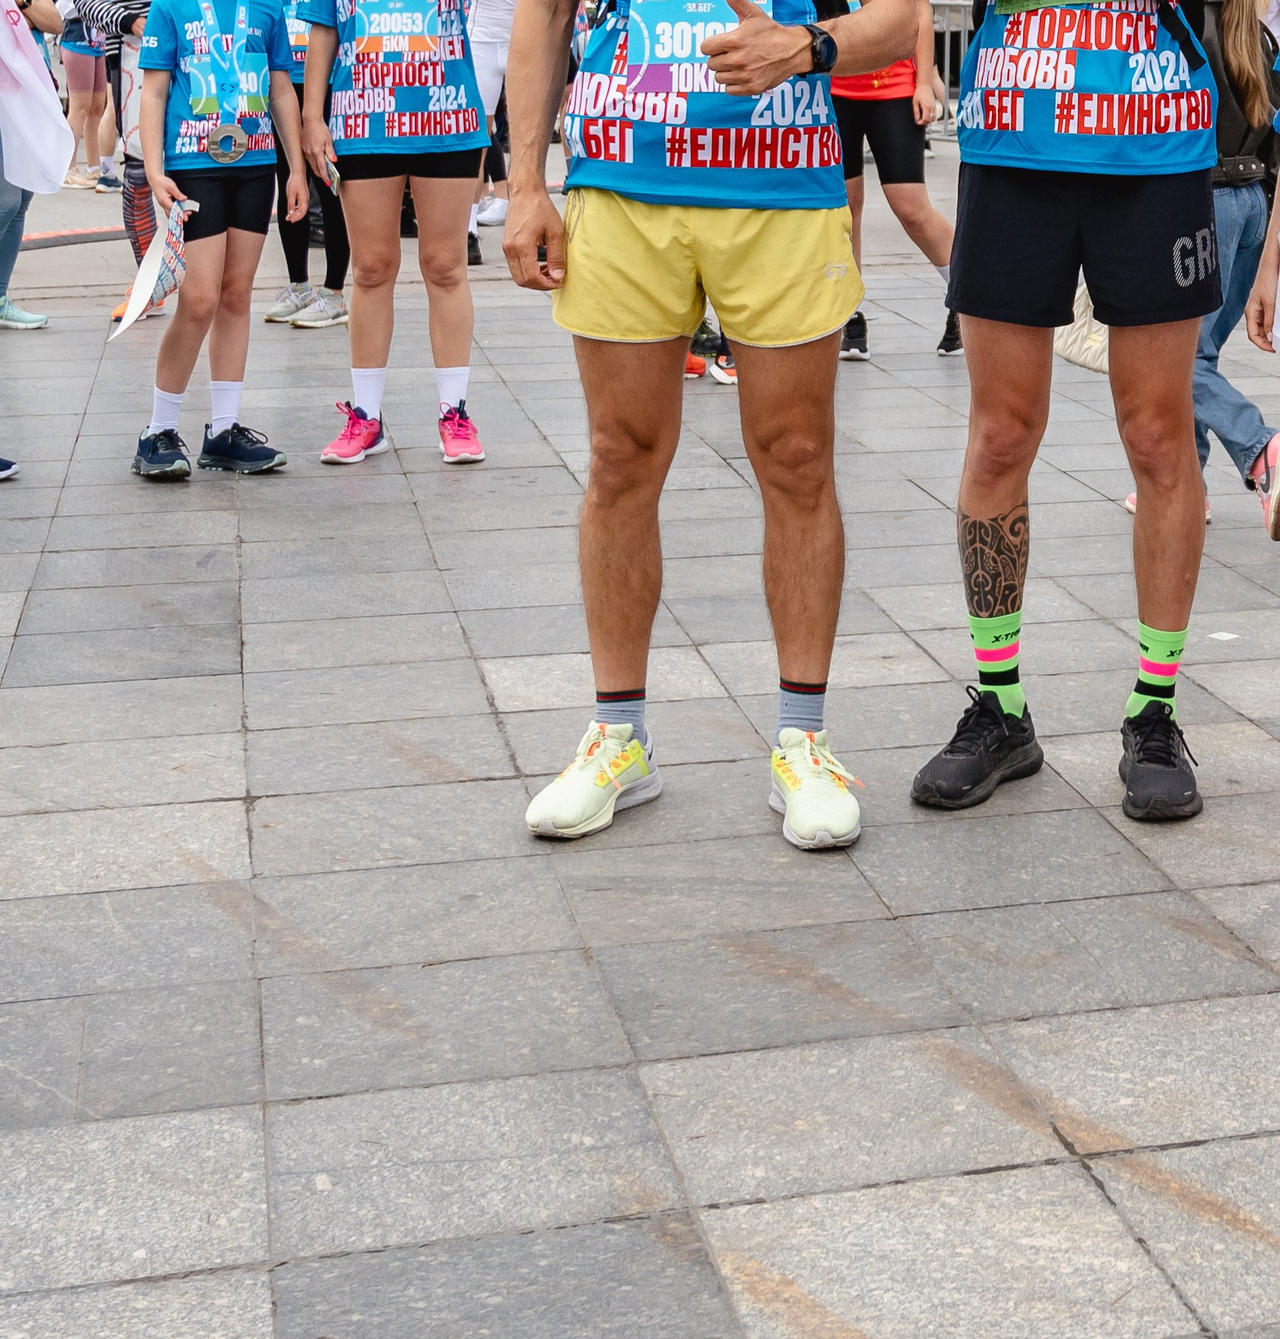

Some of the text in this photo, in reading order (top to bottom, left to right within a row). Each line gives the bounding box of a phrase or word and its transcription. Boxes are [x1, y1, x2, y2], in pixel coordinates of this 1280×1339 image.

[185, 20, 206, 40] 202
[370, 12, 423, 34] 20053
[1003, 8, 1156, 54] #ГОРДОСТЬ
[382, 35, 410, 52] 5KM
[974, 47, 1191, 92] ЛЮБОВЬ 2024
[428, 84, 467, 111] 2024
[566, 72, 829, 126] ЛЮБОВЬ 2024
[1055, 88, 1212, 135] #ЕДИНСТВО
[329, 107, 479, 141] ЗАБЕГ #ЕДИНСТВО
[564, 116, 842, 169] ЗАБЕГ #ЕДИНСТВО
